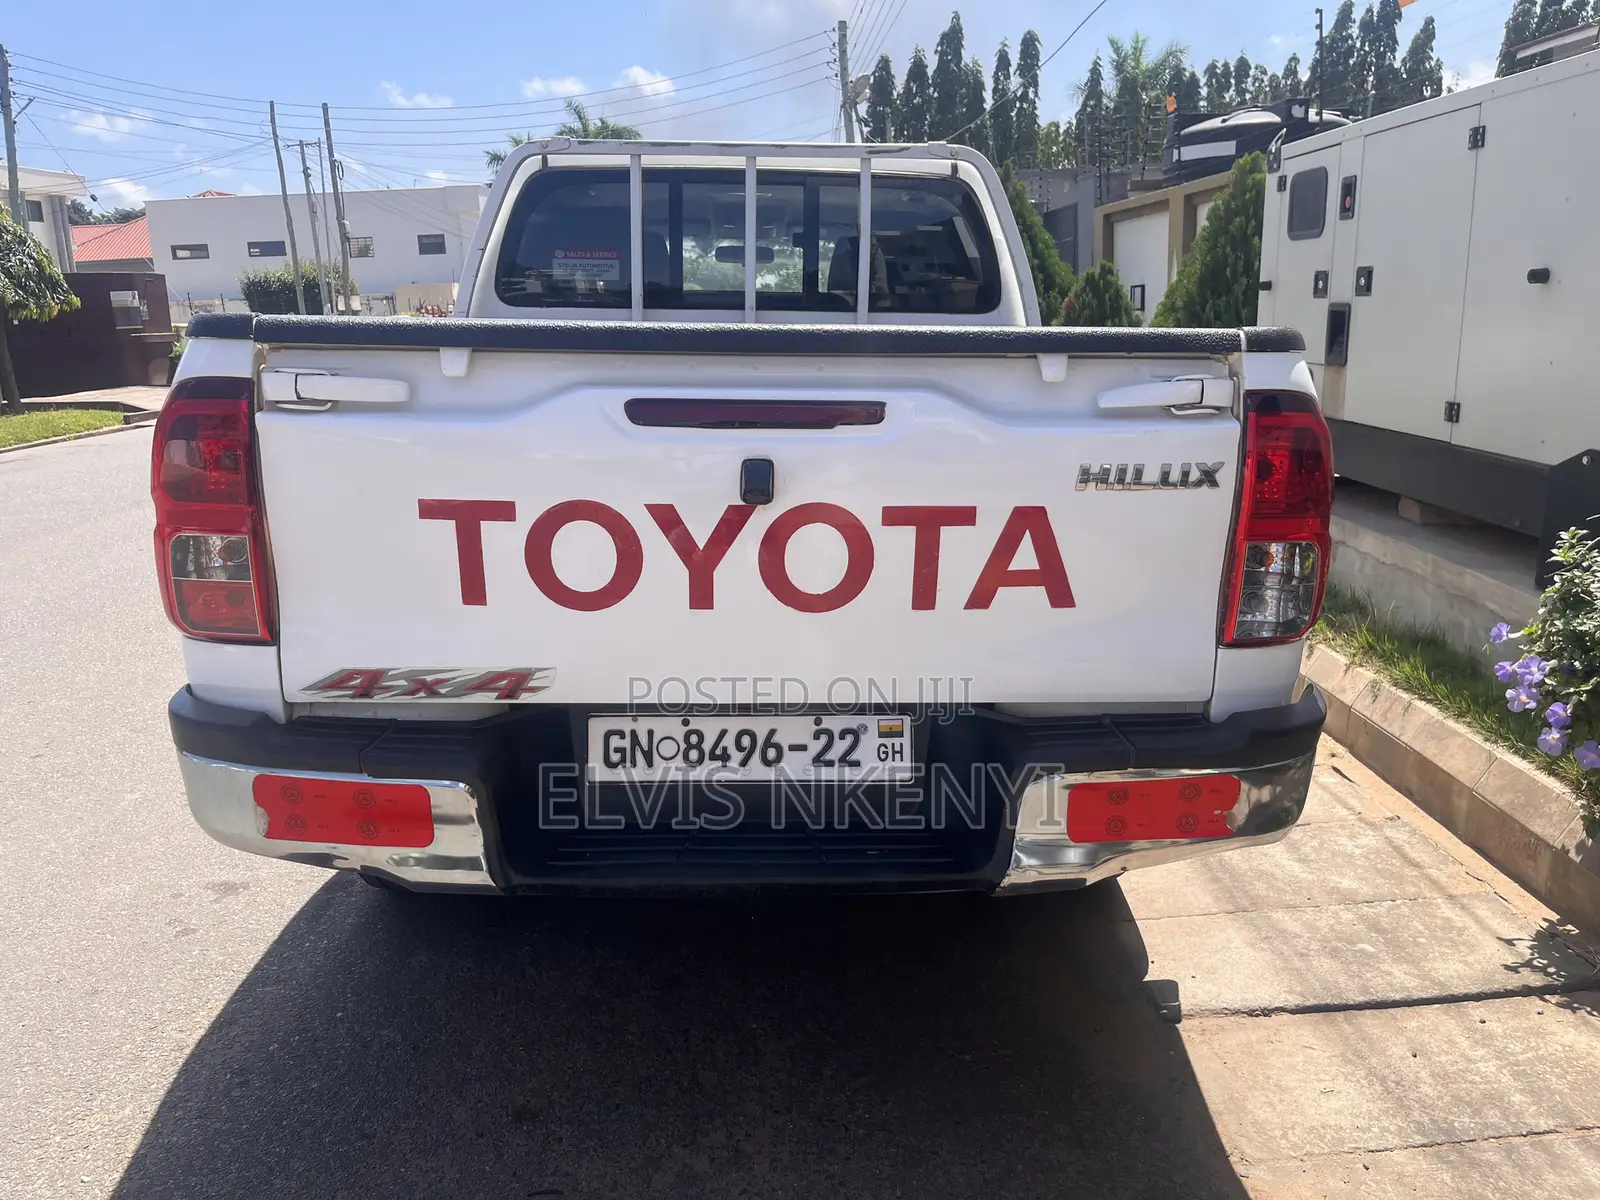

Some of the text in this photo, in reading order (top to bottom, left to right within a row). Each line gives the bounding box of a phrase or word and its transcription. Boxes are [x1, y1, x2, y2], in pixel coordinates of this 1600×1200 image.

[565, 250, 586, 258] SALES
[592, 251, 617, 259] SERVICE
[1075, 462, 1225, 491] HILUX
[418, 499, 1077, 612] TOYOTA
[876, 743, 904, 763] GH
